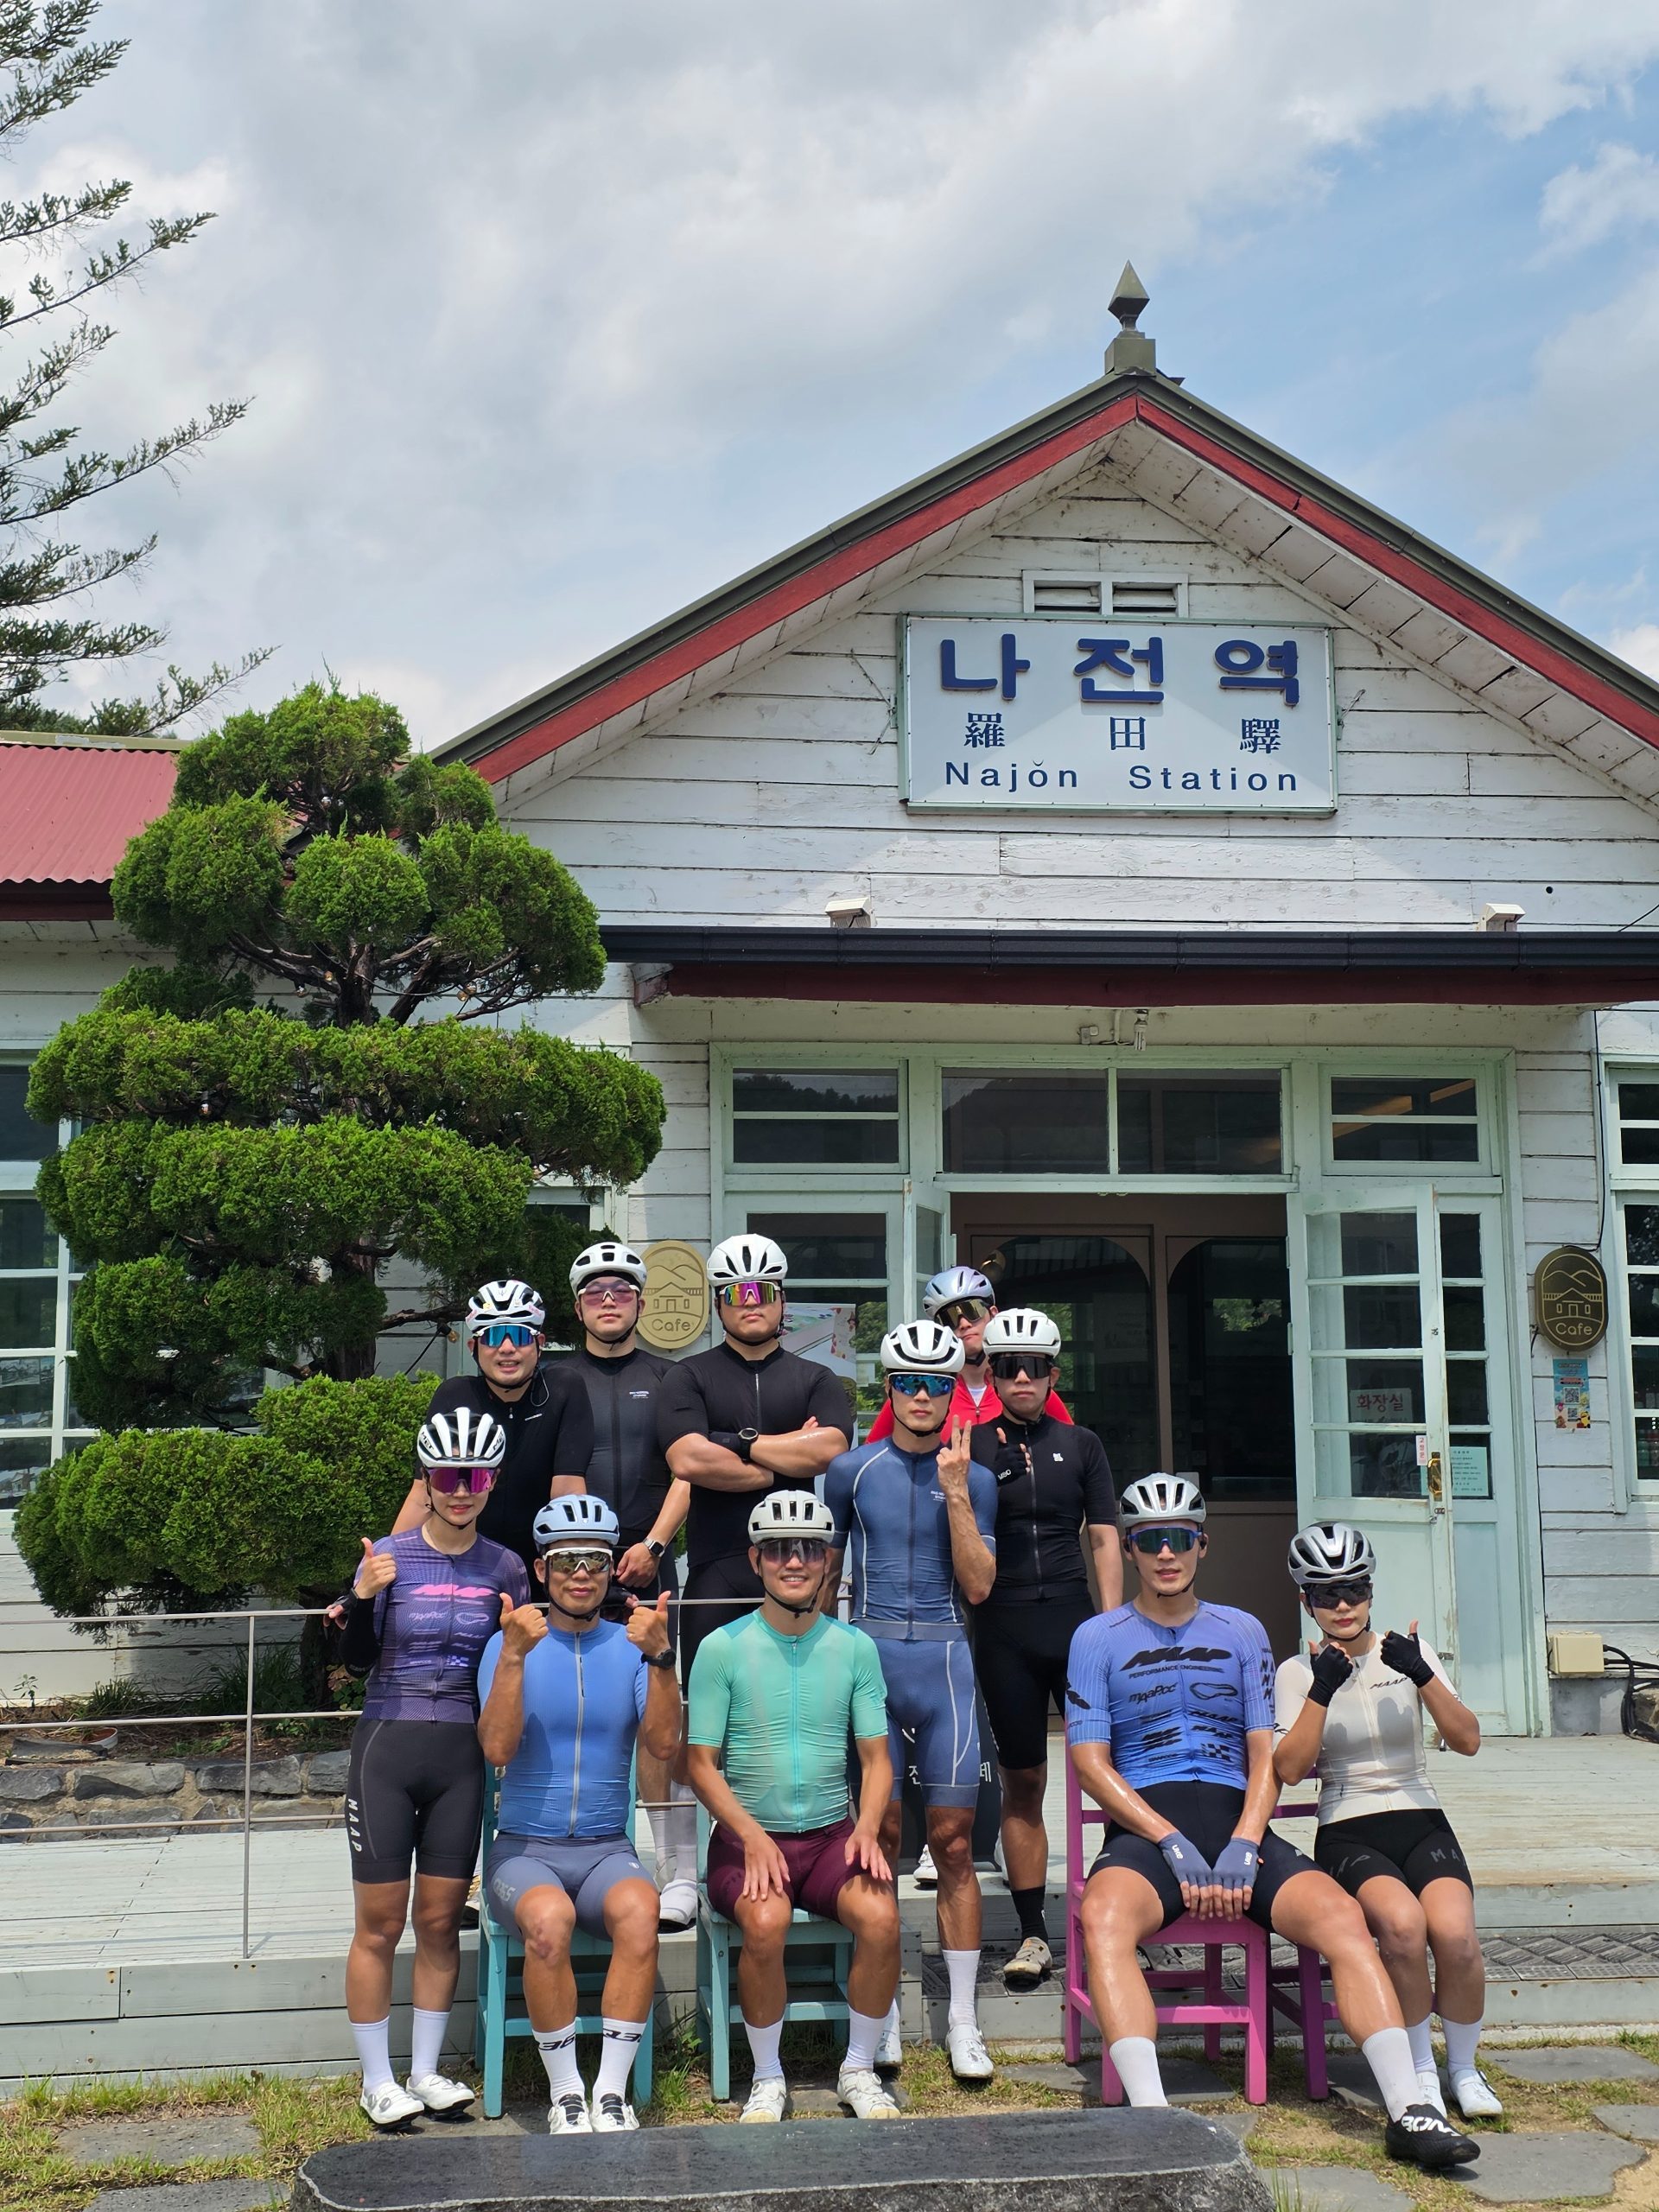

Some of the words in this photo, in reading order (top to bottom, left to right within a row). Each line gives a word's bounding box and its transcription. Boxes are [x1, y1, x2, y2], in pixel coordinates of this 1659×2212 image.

[940, 632, 1300, 707] 나전역
[963, 711, 1281, 754] 羅田驛
[1128, 765, 1298, 791] Station
[652, 1318, 691, 1332] Cafe
[1555, 1322, 1592, 1336] Cafe
[1356, 1394, 1404, 1413] 화장실
[1128, 1664, 1179, 1680] PERFORMANCE
[347, 1797, 363, 1853] MAAP
